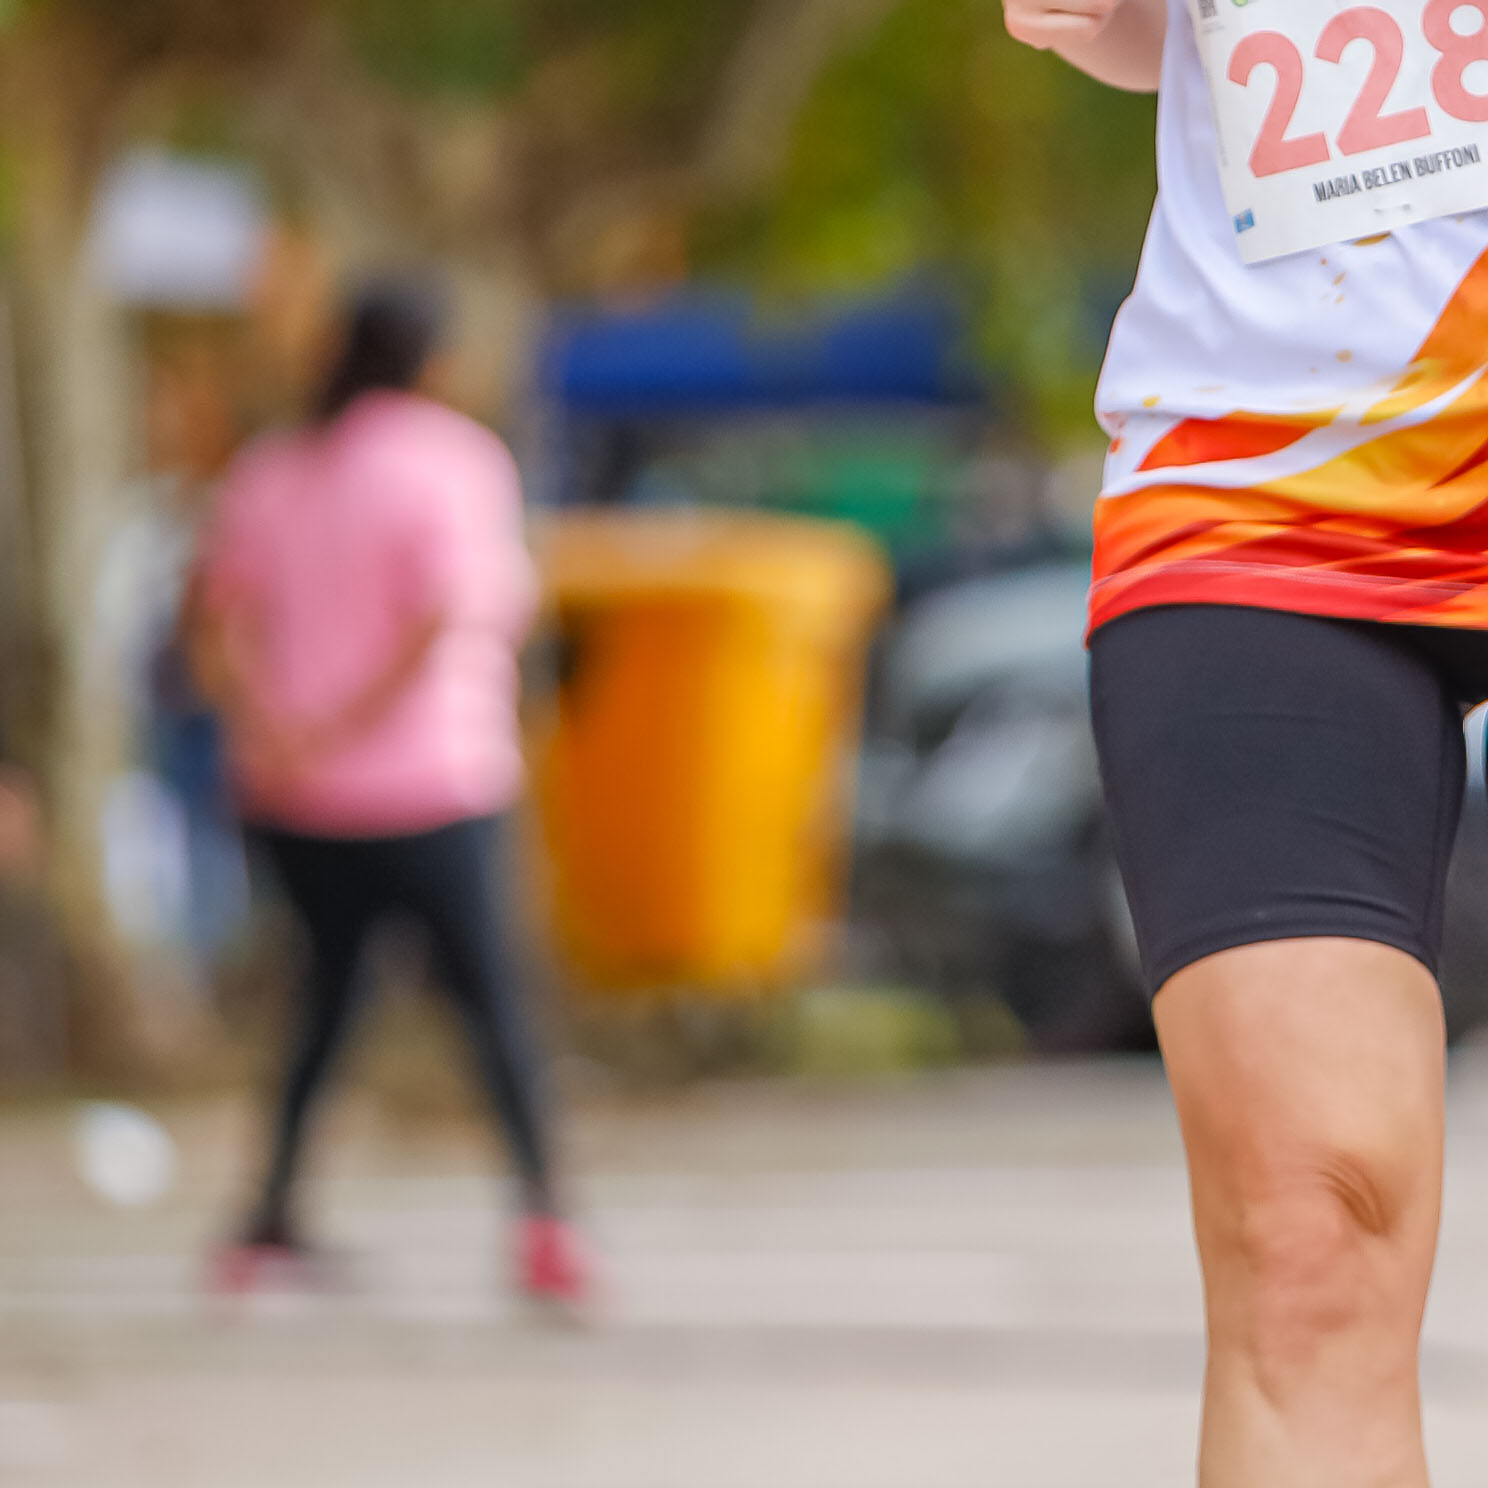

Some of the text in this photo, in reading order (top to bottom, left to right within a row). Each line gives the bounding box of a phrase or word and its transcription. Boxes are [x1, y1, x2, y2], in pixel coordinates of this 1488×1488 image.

[1312, 143, 1482, 202] MARIA BELEN BUFFONI
